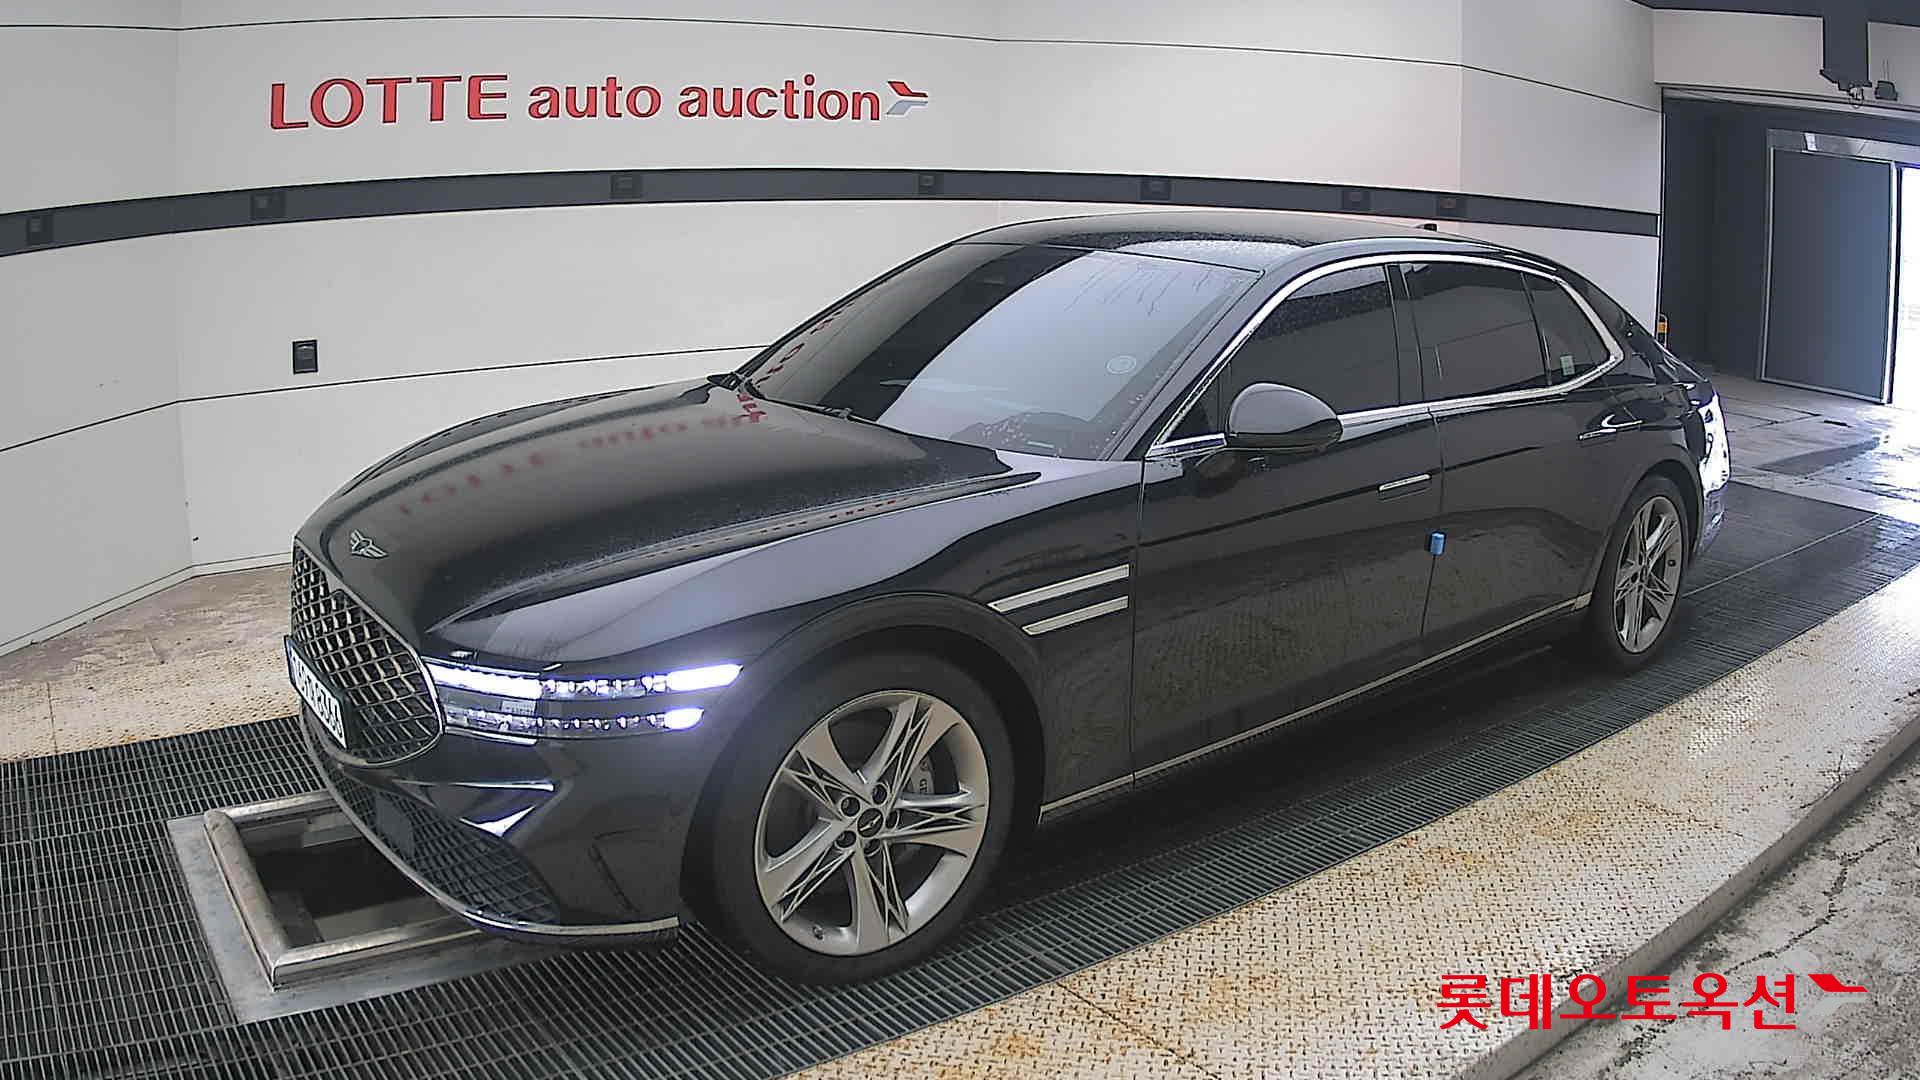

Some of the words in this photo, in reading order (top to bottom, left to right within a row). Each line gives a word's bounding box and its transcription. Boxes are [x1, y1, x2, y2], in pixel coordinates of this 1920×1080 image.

[270, 74, 507, 130] LOTTE
[527, 76, 662, 120] auto
[677, 73, 880, 121] auction
